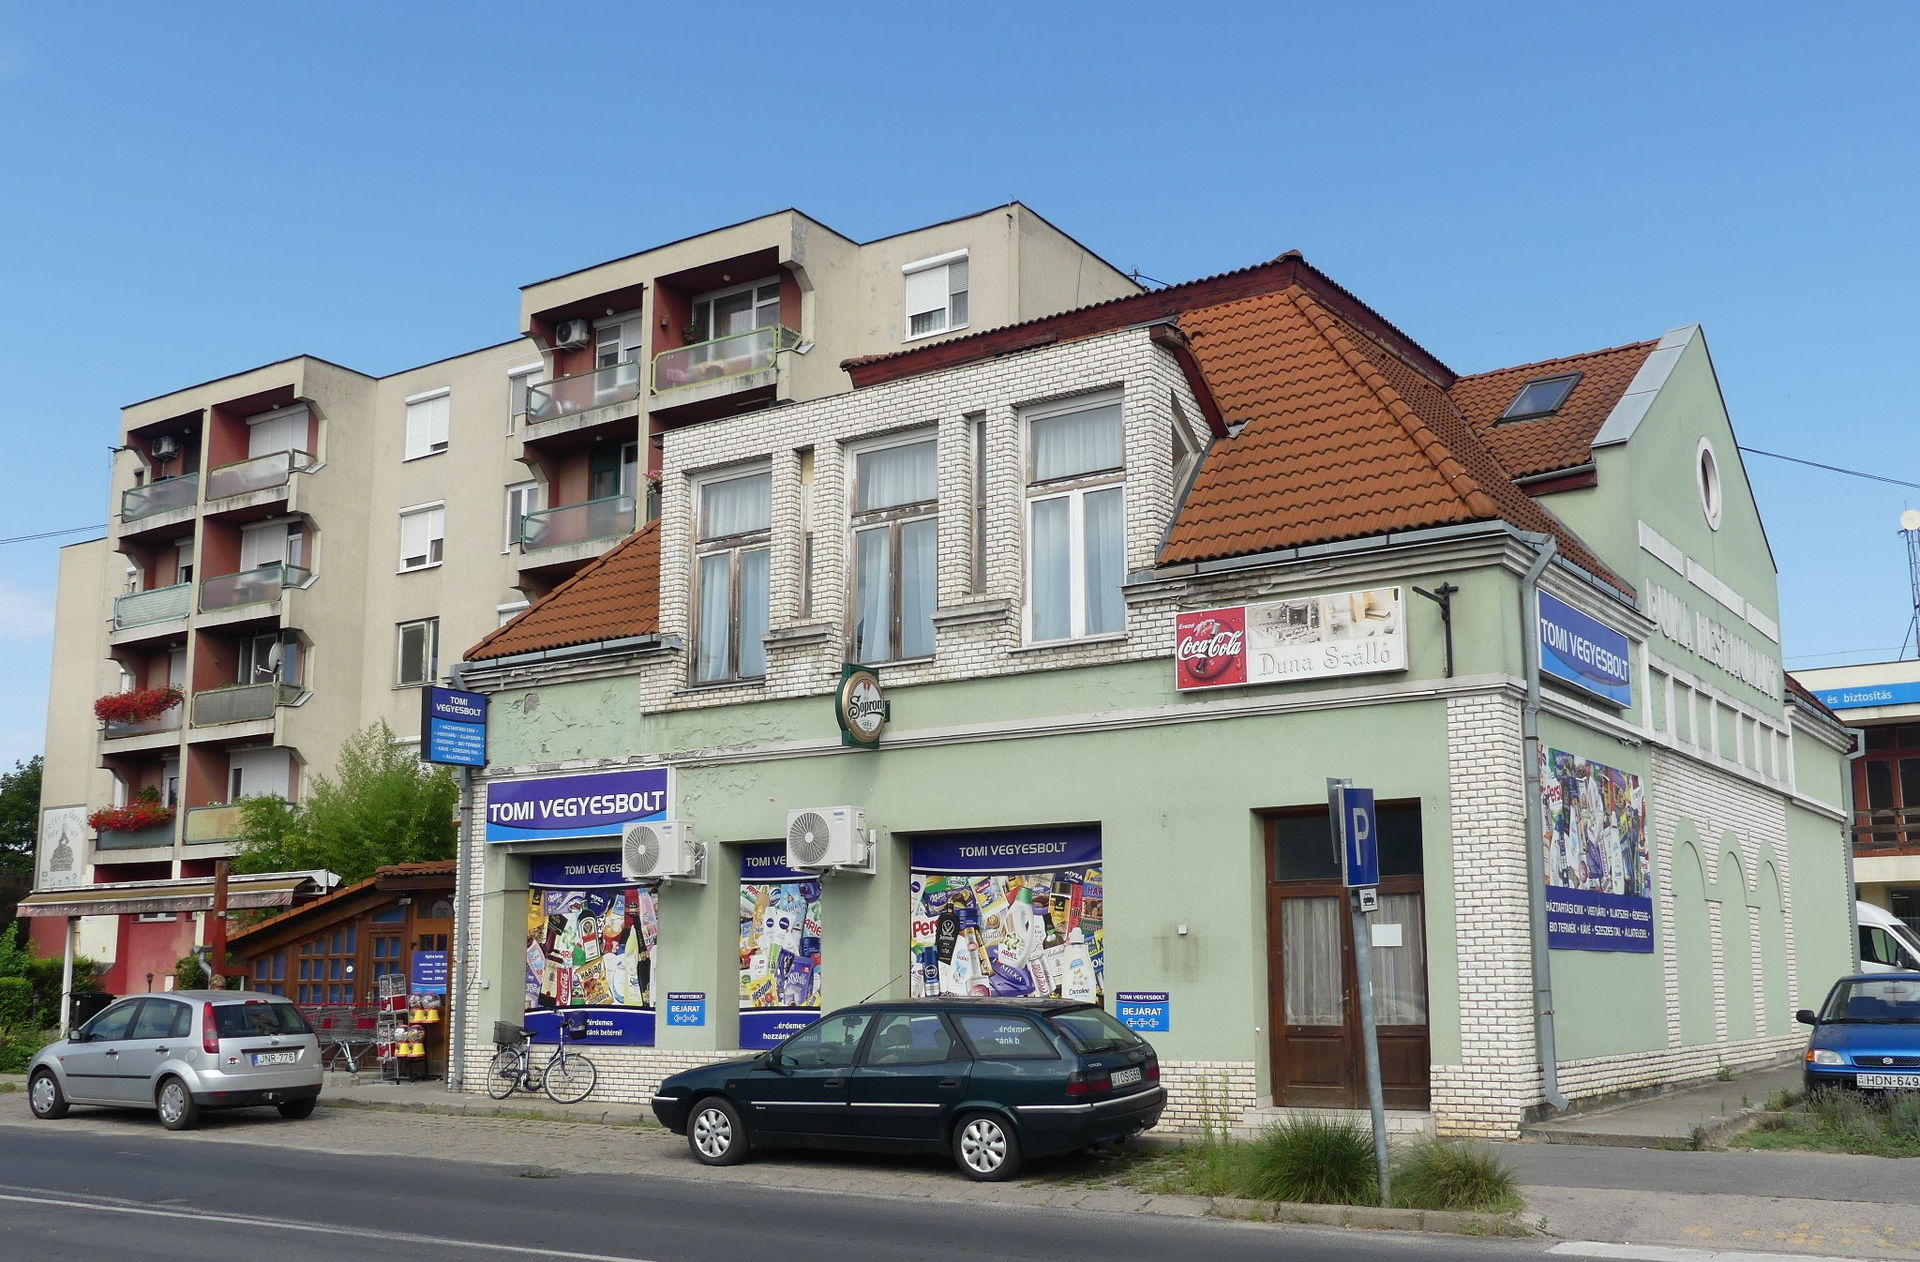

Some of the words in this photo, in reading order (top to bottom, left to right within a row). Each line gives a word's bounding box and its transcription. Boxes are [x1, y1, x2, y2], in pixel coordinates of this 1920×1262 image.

[1178, 630, 1244, 661] Coca-Cola
[1540, 618, 1568, 652] TOMI
[1569, 631, 1629, 682] VEGYESBOLT
[1258, 652, 1312, 676] Duna
[450, 696, 468, 706] TOMI
[1826, 694, 1838, 704] és
[1844, 691, 1892, 702] biztosítás
[436, 704, 482, 716] VEGYESBOLT
[848, 695, 885, 720] Soproni
[490, 800, 534, 822] TOMI
[539, 790, 664, 818] VEGYESBOLT
[1352, 807, 1370, 866] P
[959, 846, 988, 858] TOMI
[990, 842, 1067, 856] VEGYESBOLT
[564, 864, 586, 876] TOMI
[588, 863, 622, 874] VEGYES
[746, 856, 770, 867] TOMI
[1088, 887, 1103, 896] HAR
[804, 918, 822, 936] ARIE
[912, 920, 939, 938] Per
[1001, 949, 1018, 960] ARIEL
[580, 962, 602, 978] HARIBO
[1001, 965, 1022, 982] MILKA
[1122, 1006, 1162, 1016] BEJÁRAT
[1866, 1076, 1919, 1086] HDN-649
